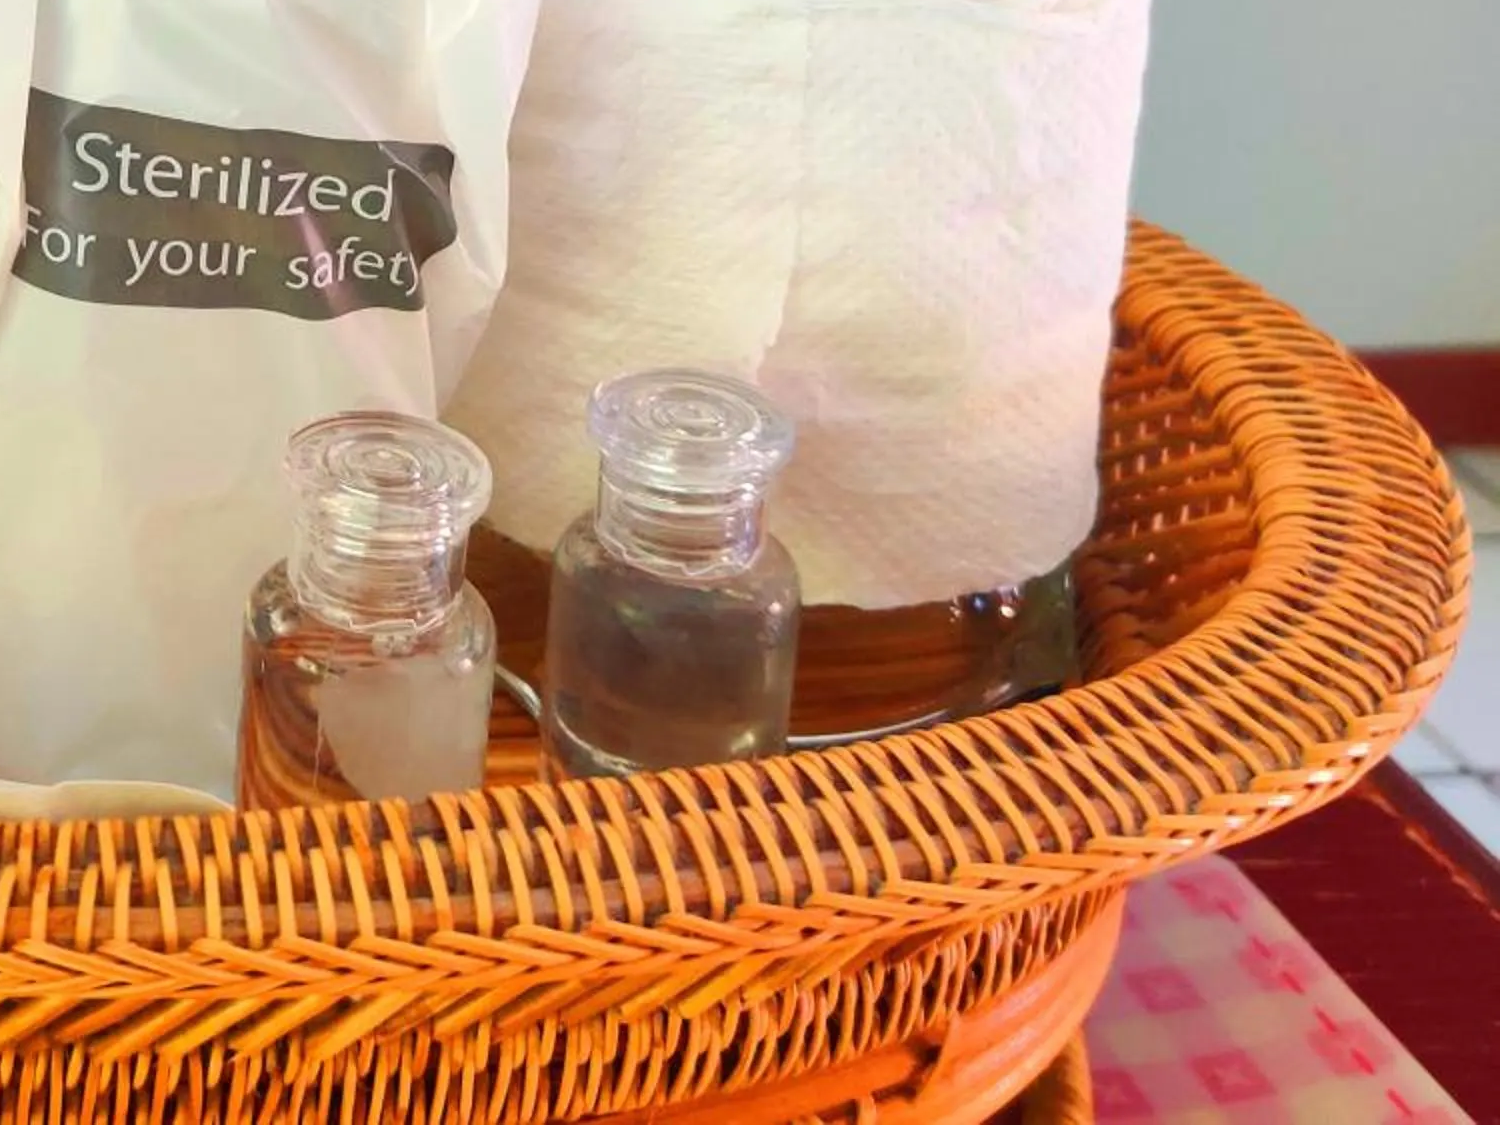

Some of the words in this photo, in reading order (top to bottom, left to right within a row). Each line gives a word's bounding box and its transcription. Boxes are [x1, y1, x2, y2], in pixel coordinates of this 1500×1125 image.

[72, 132, 395, 221] Sterilized
[22, 204, 97, 266] For
[126, 239, 257, 286] your
